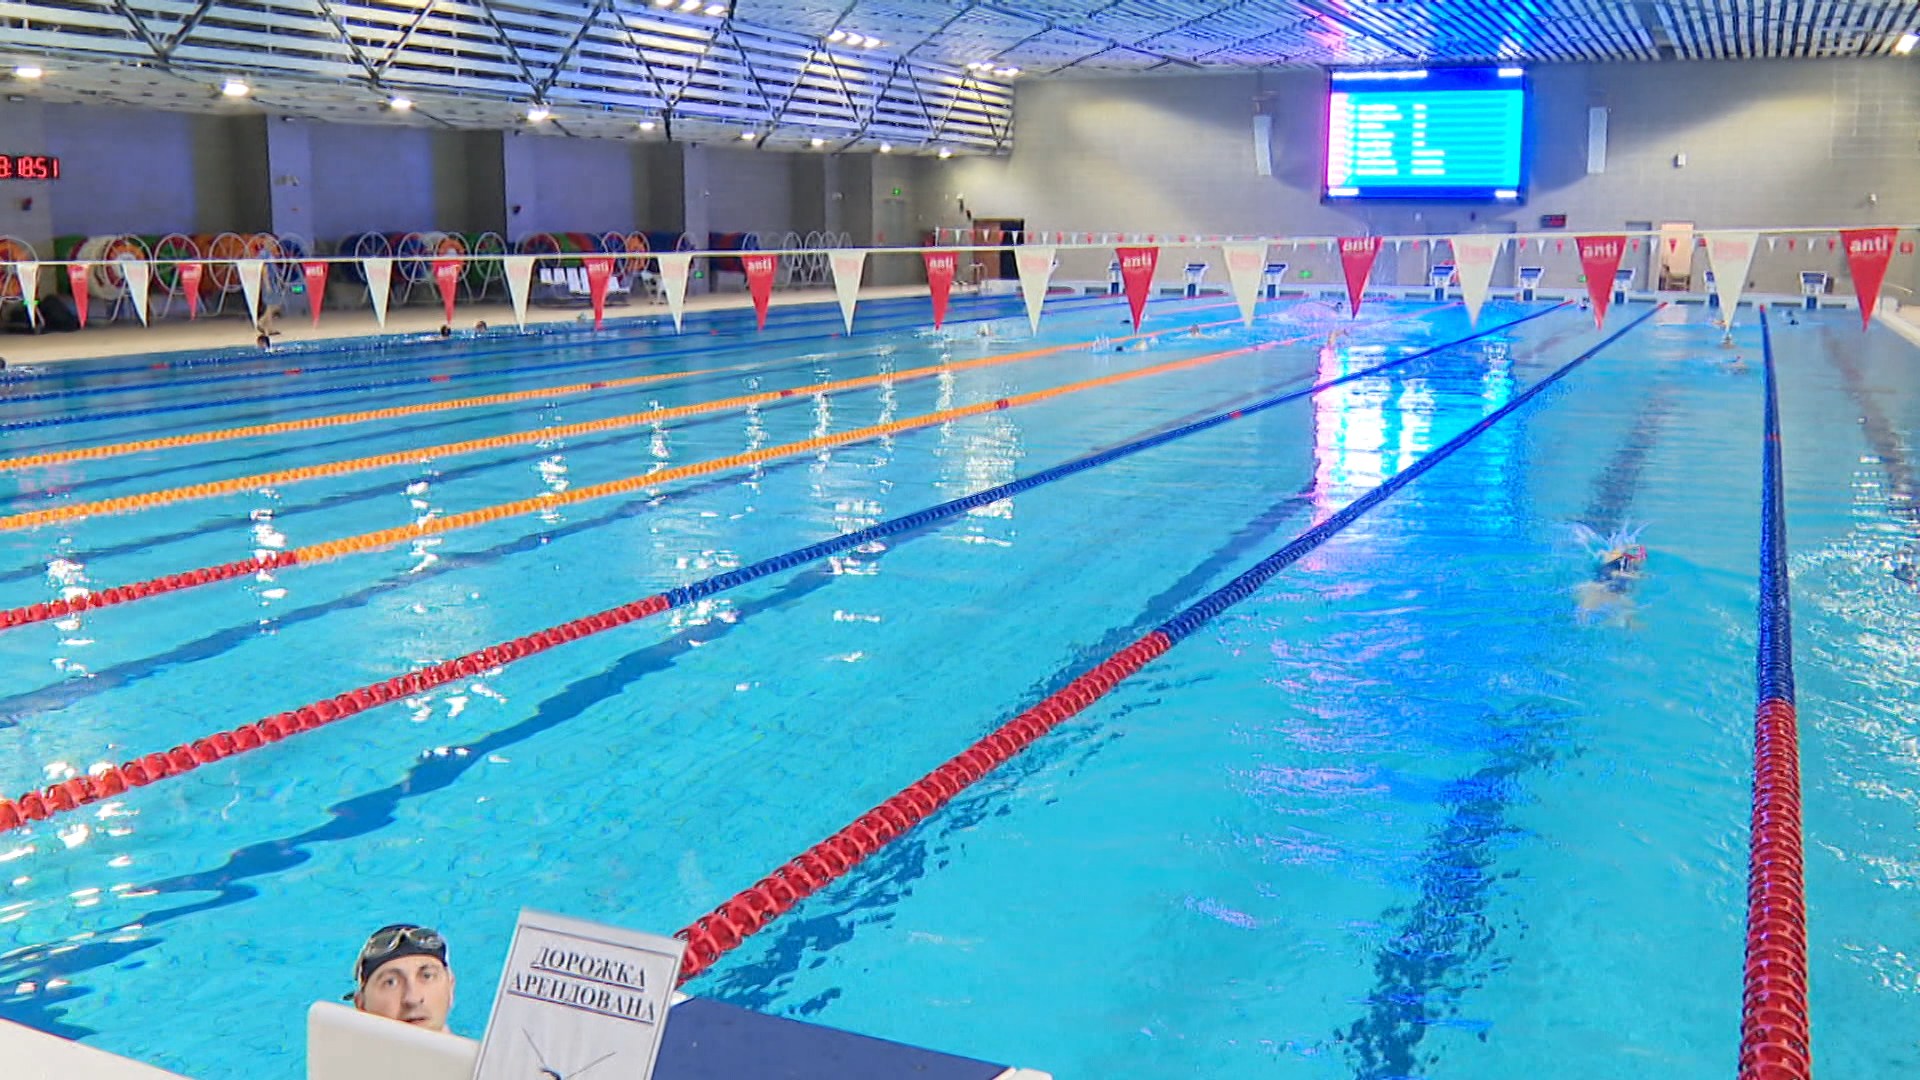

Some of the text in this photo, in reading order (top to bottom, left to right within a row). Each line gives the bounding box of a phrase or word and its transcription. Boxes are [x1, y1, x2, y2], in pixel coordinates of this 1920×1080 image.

[1343, 236, 1376, 252] anti
[1583, 242, 1619, 259] anti
[1850, 236, 1888, 253] anti
[748, 257, 773, 272] anti
[929, 257, 954, 270] anti
[1123, 252, 1152, 268] anti
[531, 946, 646, 988] ДОРОЖКА
[509, 973, 656, 1022] АРЕНДОВАНА
